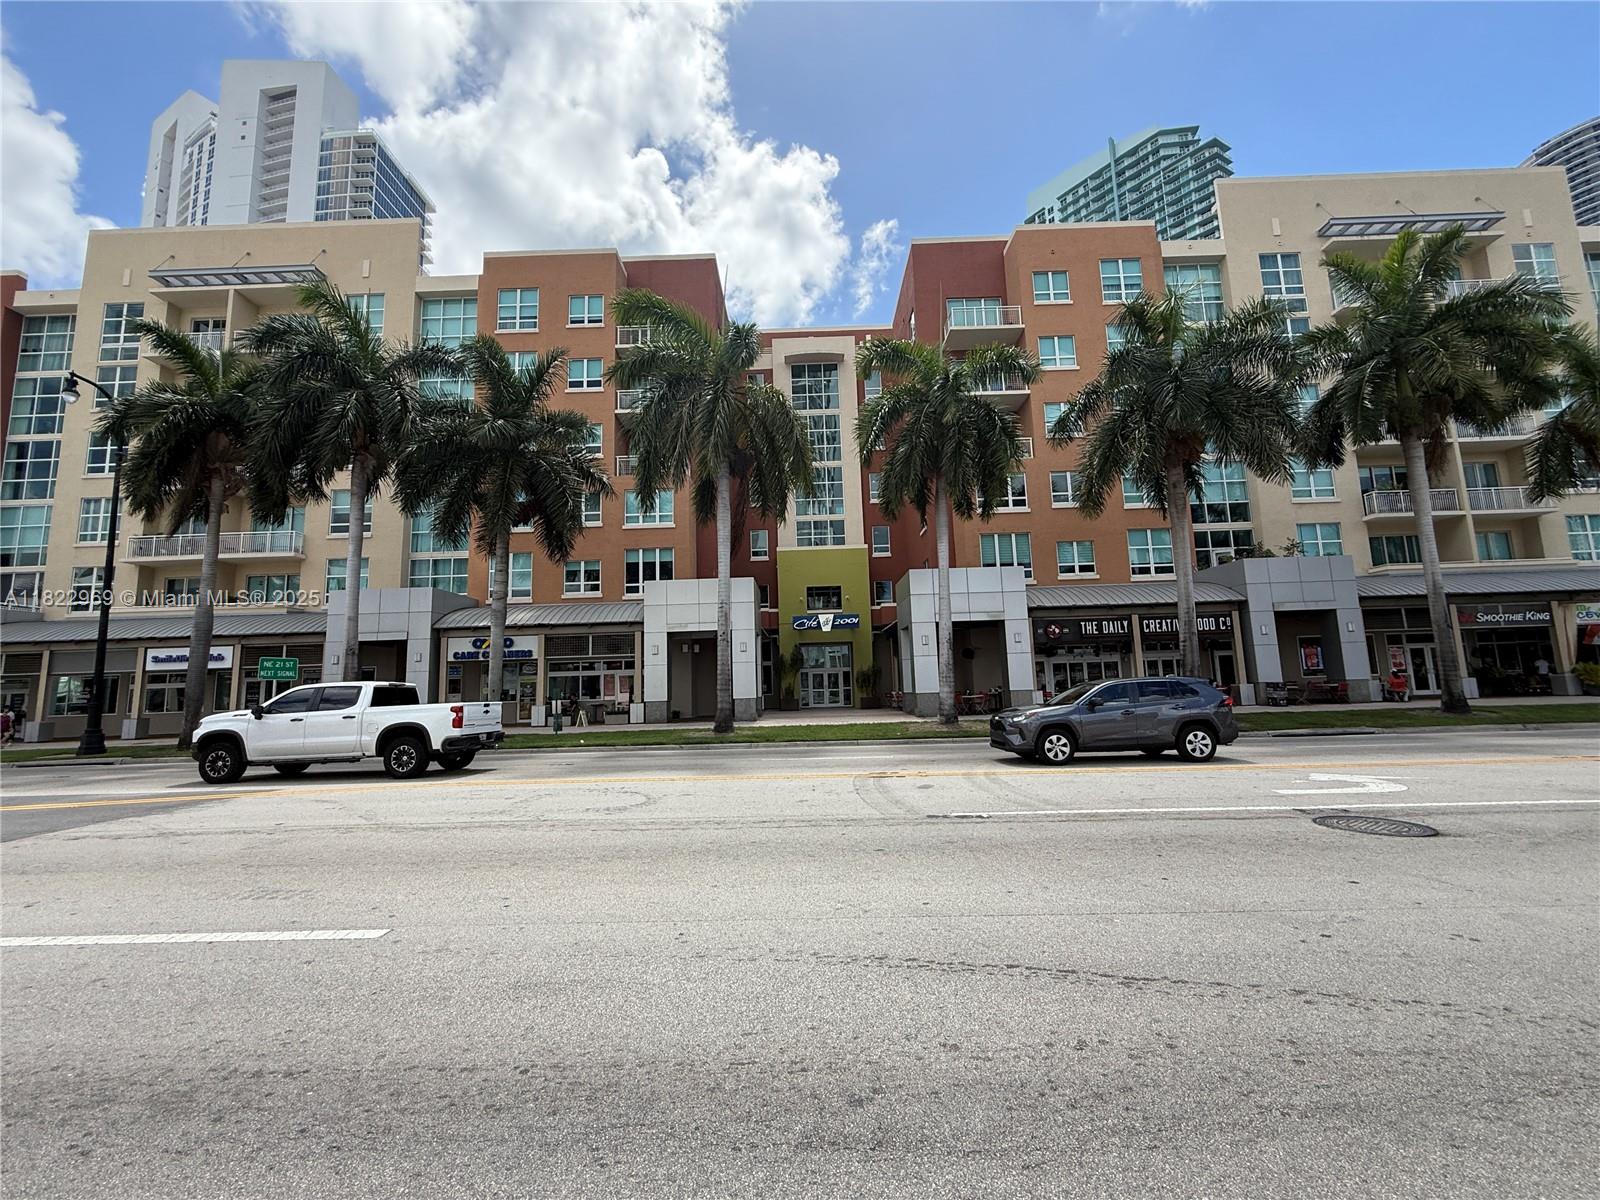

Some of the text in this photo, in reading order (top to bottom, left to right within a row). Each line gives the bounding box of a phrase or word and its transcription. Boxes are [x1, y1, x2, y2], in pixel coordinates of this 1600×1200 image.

[833, 617, 859, 625] 2001
[1080, 621, 1099, 634] THE
[1102, 620, 1129, 634] DAILY
